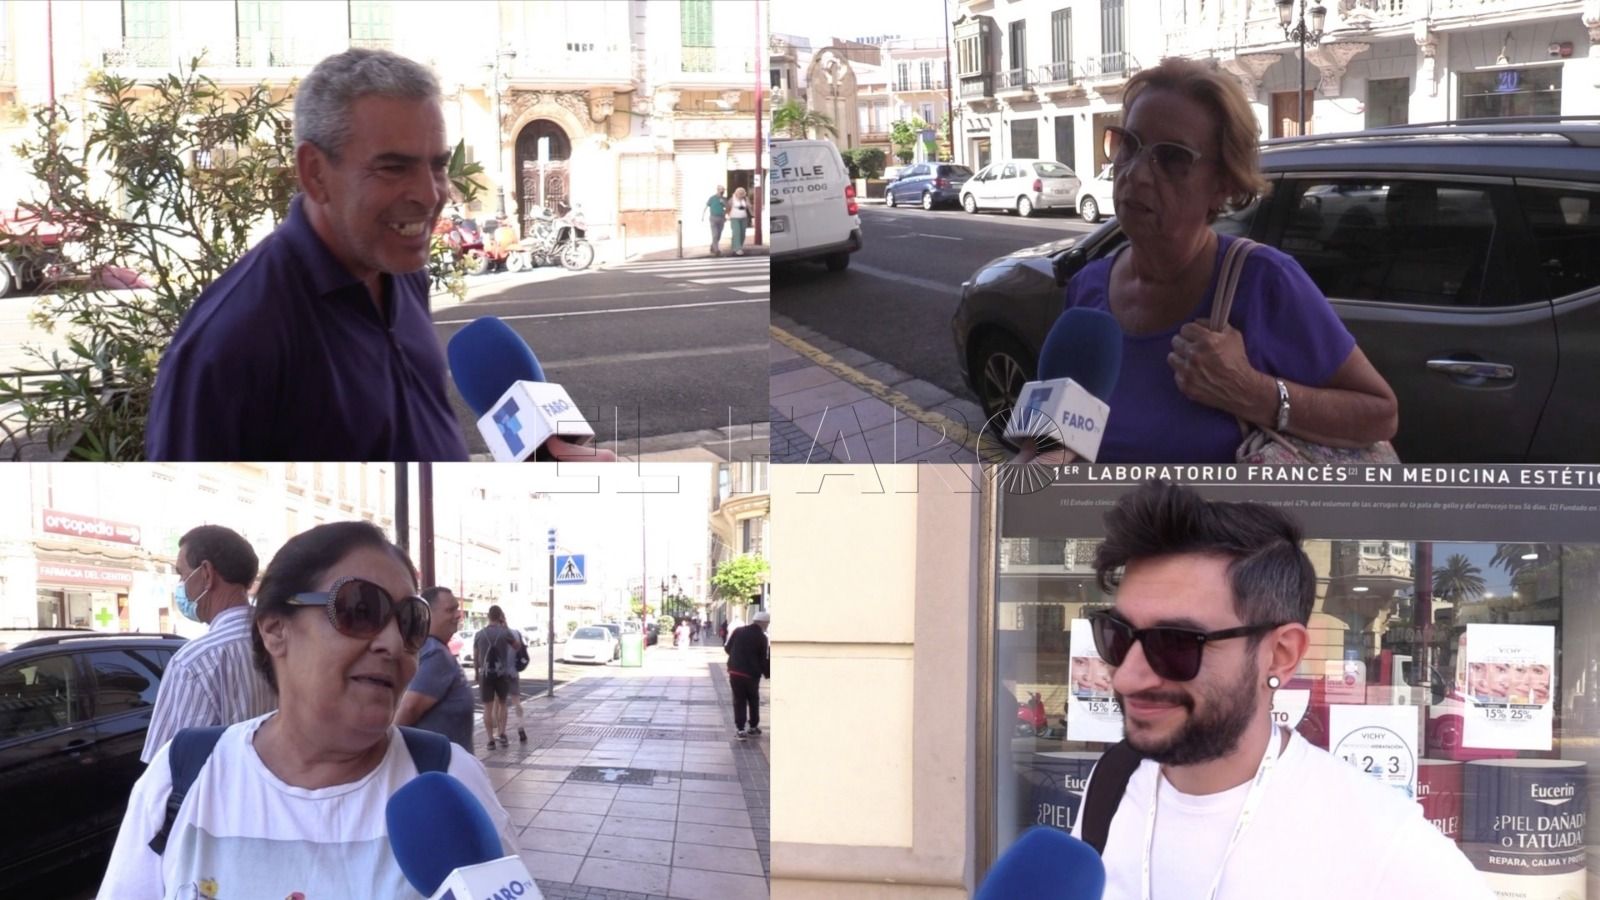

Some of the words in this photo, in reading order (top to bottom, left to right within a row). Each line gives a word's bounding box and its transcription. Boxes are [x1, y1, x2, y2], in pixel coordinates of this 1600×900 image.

[770, 165, 824, 179] EFILE
[771, 188, 779, 196] 0
[541, 399, 569, 417] FARO
[1062, 411, 1095, 432] FARO
[1088, 466, 1238, 481] LABORATORIO
[1365, 467, 1393, 482] EN
[1403, 467, 1511, 484] MEDICINA
[46, 516, 114, 537] ortopedia
[1088, 702, 1109, 712] 15%
[1485, 708, 1507, 719] 15%
[1511, 709, 1532, 720] 25%
[1272, 711, 1289, 722] TO
[1388, 756, 1400, 774] 3
[1065, 774, 1087, 790] Euc
[1531, 783, 1574, 798] Eucerin
[1493, 815, 1534, 832] ¿PIEL
[1538, 811, 1586, 832] DAÑAD
[1489, 856, 1530, 868] REPARA,
[1531, 857, 1561, 868] CALMA
[1562, 857, 1567, 866] Y
[485, 881, 524, 900] ARO
